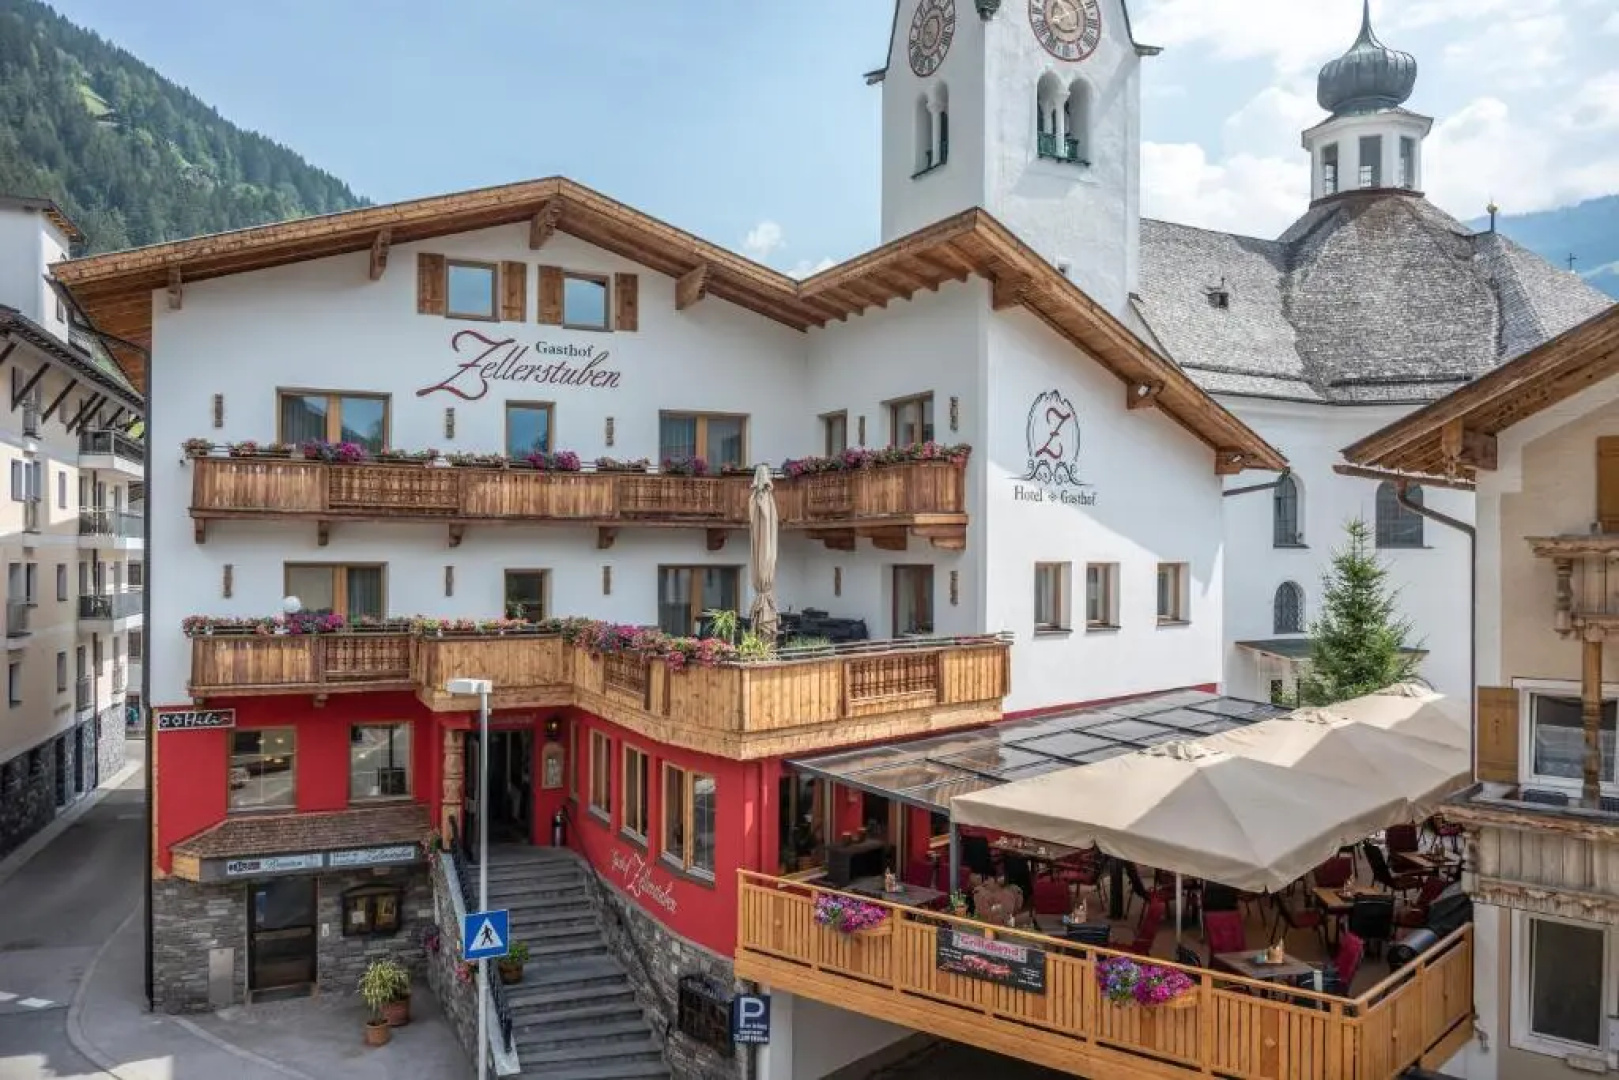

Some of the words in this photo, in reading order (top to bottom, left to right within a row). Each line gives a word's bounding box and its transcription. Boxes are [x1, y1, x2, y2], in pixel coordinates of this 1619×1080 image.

[535, 341, 595, 358] Gasthof
[415, 329, 621, 401] Zellerstuben
[1014, 485, 1043, 502] Hotel
[1060, 489, 1097, 506] Gasthof
[960, 932, 1020, 957] Grillabend
[740, 997, 765, 1028] P
